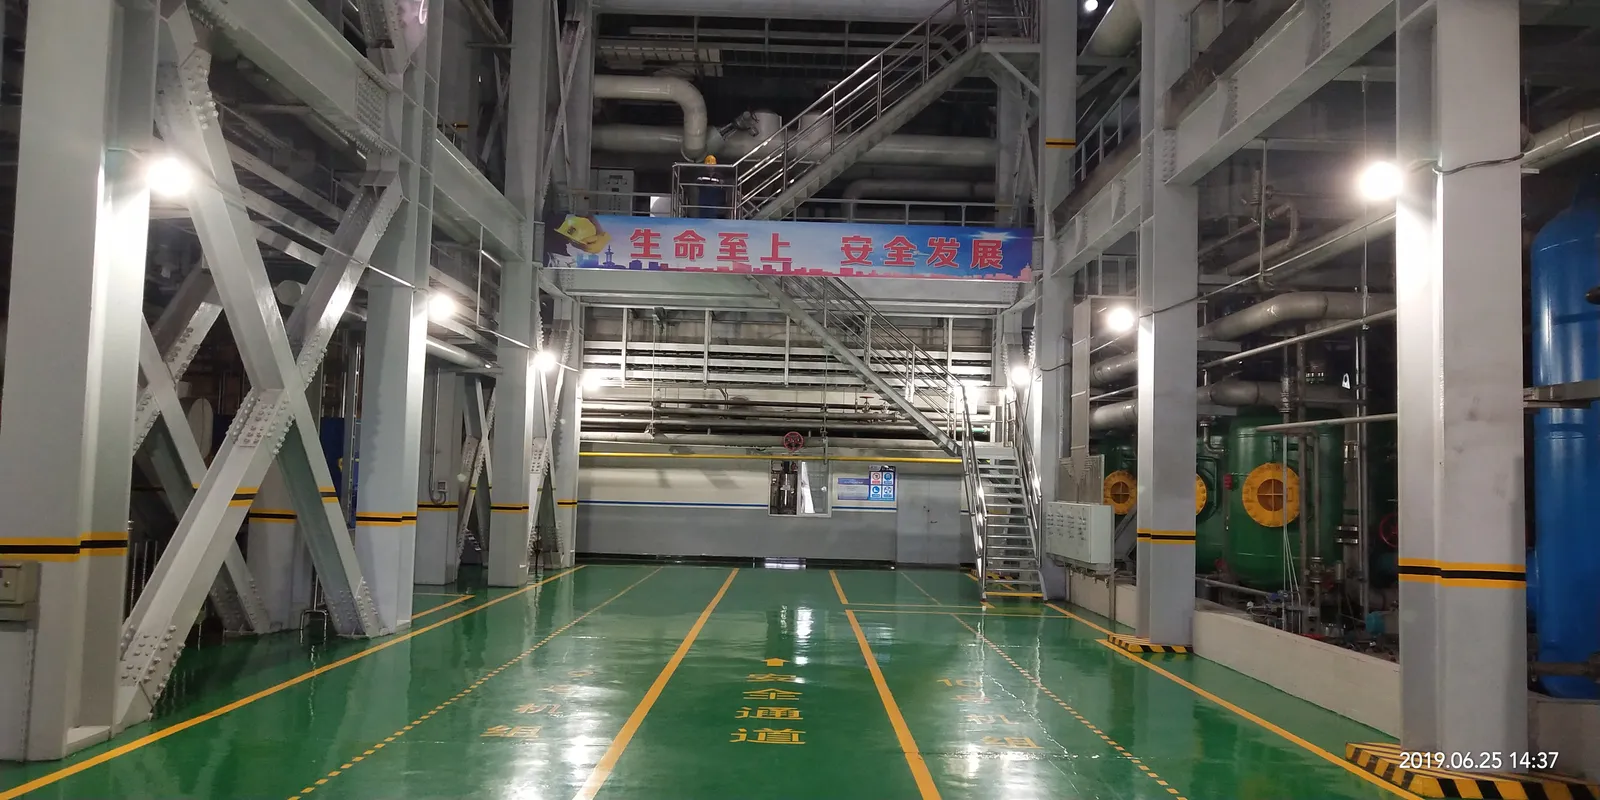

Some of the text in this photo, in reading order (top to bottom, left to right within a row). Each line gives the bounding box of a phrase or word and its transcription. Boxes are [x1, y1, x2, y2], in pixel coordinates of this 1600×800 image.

[629, 228, 1004, 269] 生命至上 安全发展
[729, 673, 806, 744] 安全通道
